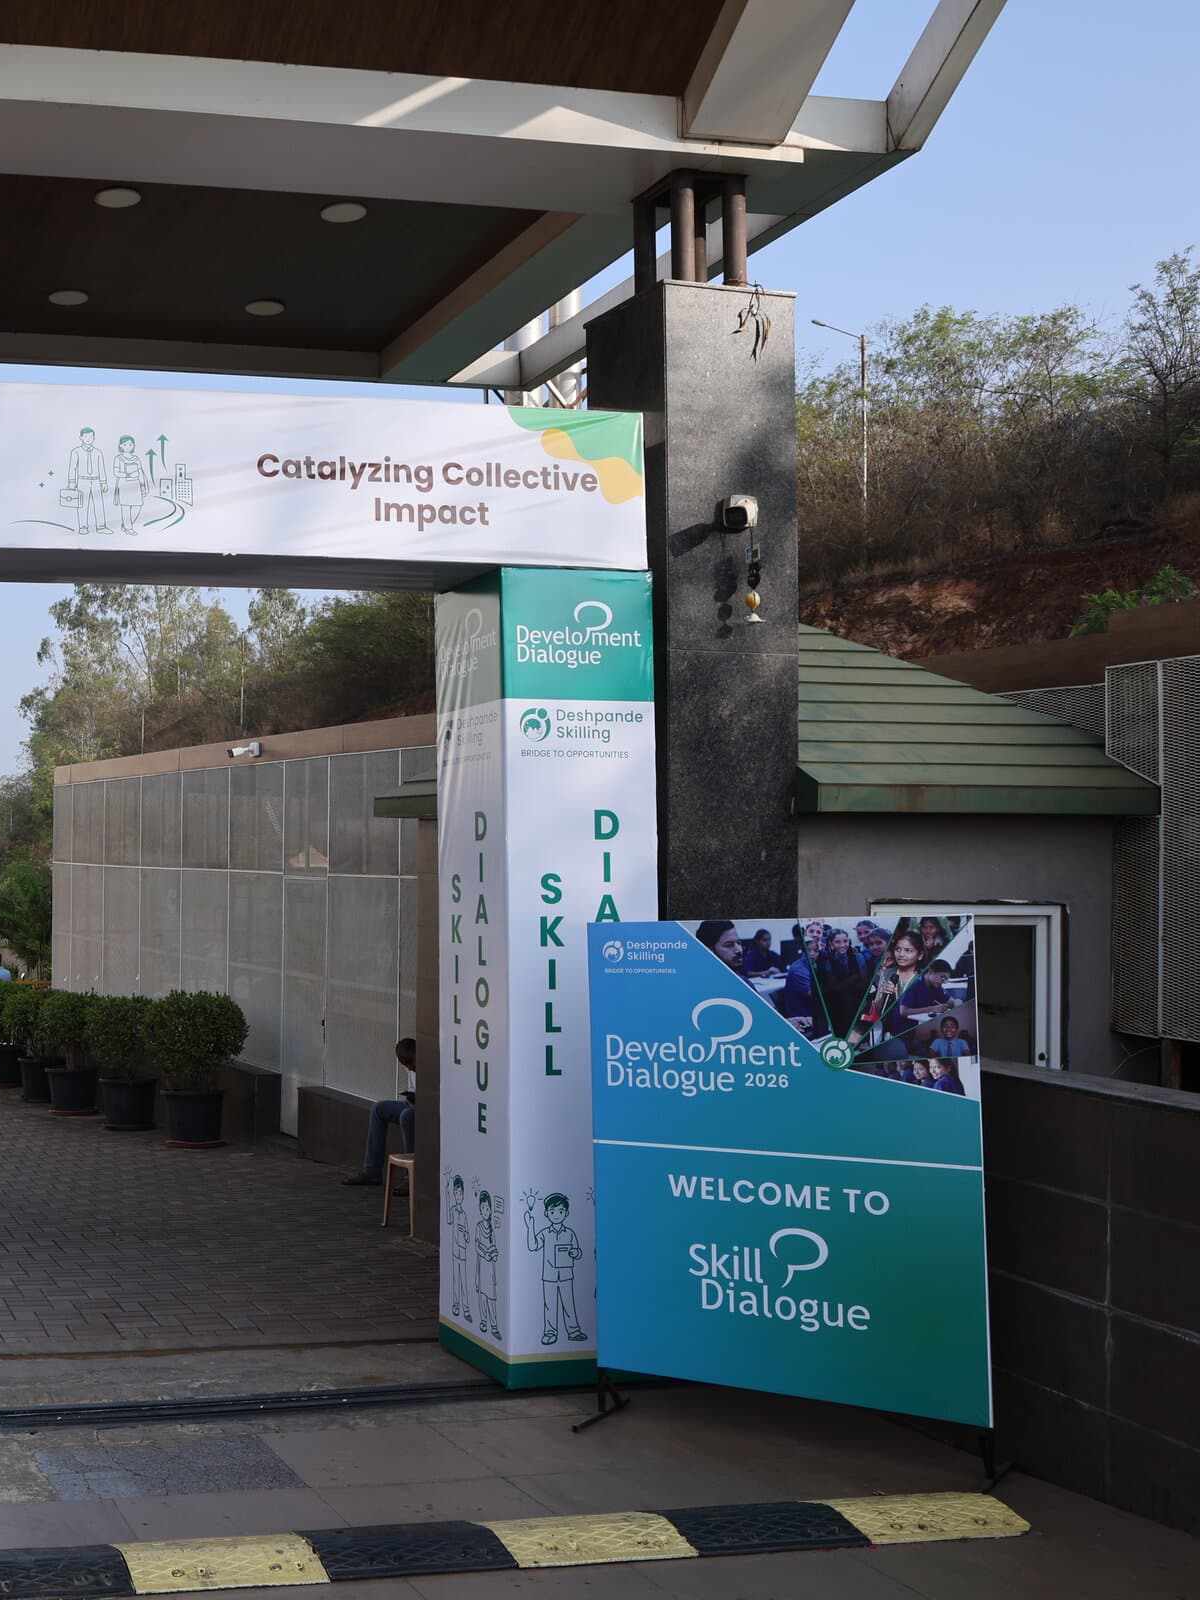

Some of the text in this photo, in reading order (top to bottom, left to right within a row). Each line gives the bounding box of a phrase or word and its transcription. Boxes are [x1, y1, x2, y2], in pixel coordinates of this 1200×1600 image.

[257, 453, 598, 493] Catalyzing Collective
[374, 497, 489, 530] Impact
[517, 644, 601, 668] Dialogue
[556, 709, 643, 725] Deshpande
[556, 726, 611, 743] Skilling
[521, 749, 629, 759] BRIDGE TO OPPORTUNITIES
[626, 941, 688, 951] Deshpande
[627, 952, 665, 963] Skilling
[451, 873, 462, 1065] SKILL
[474, 811, 490, 1134] DIALOGUE
[539, 873, 565, 1076] SKILL
[607, 1060, 789, 1097] Dialogue 2026
[668, 1173, 890, 1216] WELCOME TO
[688, 1243, 763, 1284] Skill
[700, 1278, 871, 1332] Dialogue
